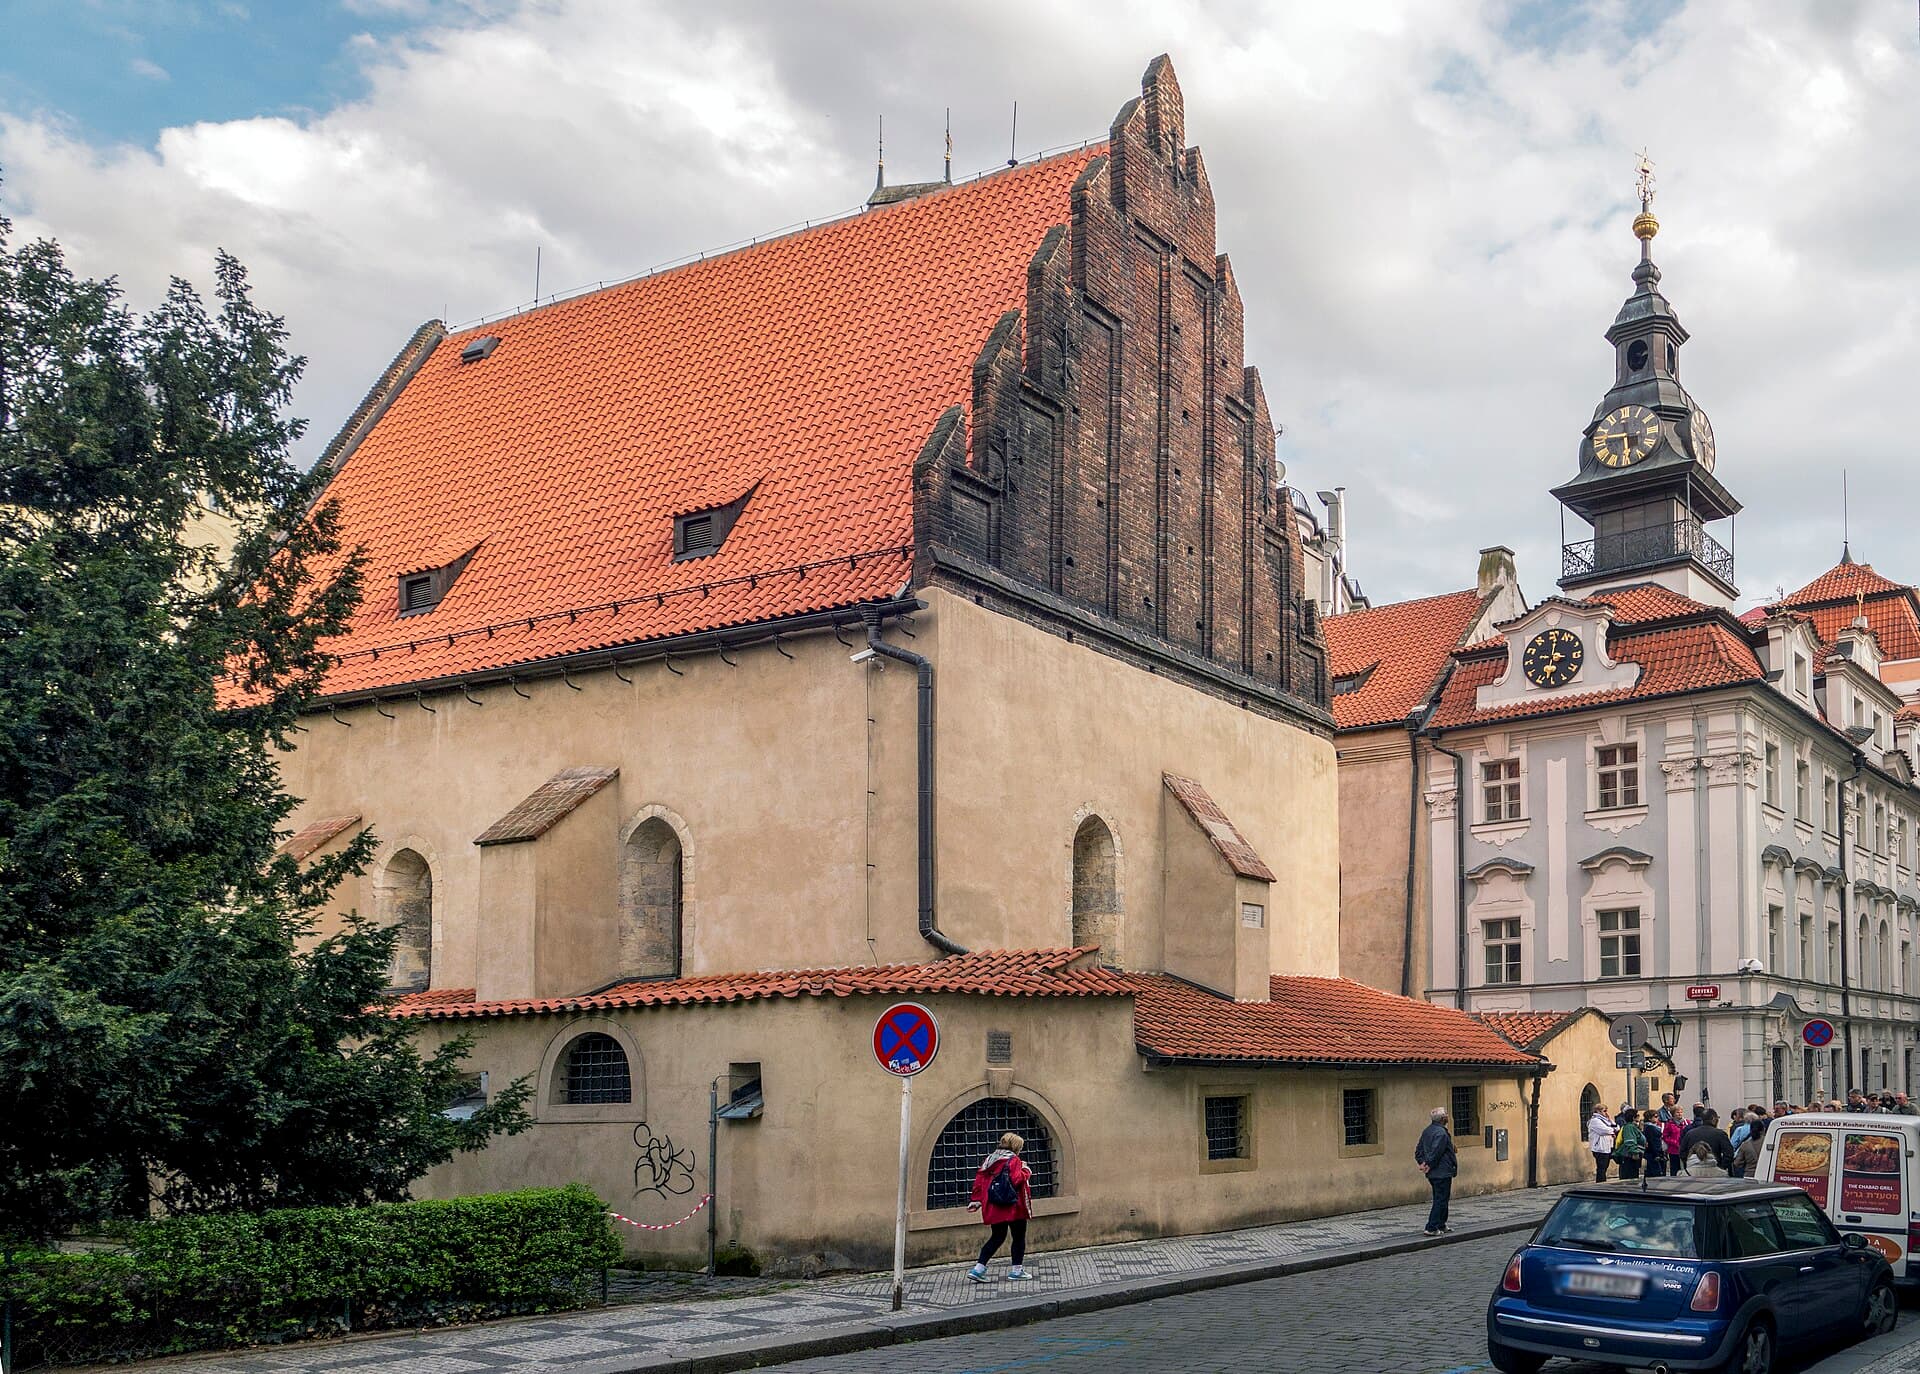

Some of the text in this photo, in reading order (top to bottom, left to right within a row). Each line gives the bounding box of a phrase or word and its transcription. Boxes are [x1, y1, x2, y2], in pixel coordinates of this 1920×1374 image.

[1620, 407, 1630, 419] XII
[1635, 407, 1642, 418] I
[1606, 415, 1617, 426] XI
[1641, 413, 1655, 424] II
[1597, 426, 1609, 434] X
[1646, 424, 1659, 435] III
[1636, 449, 1645, 459] V
